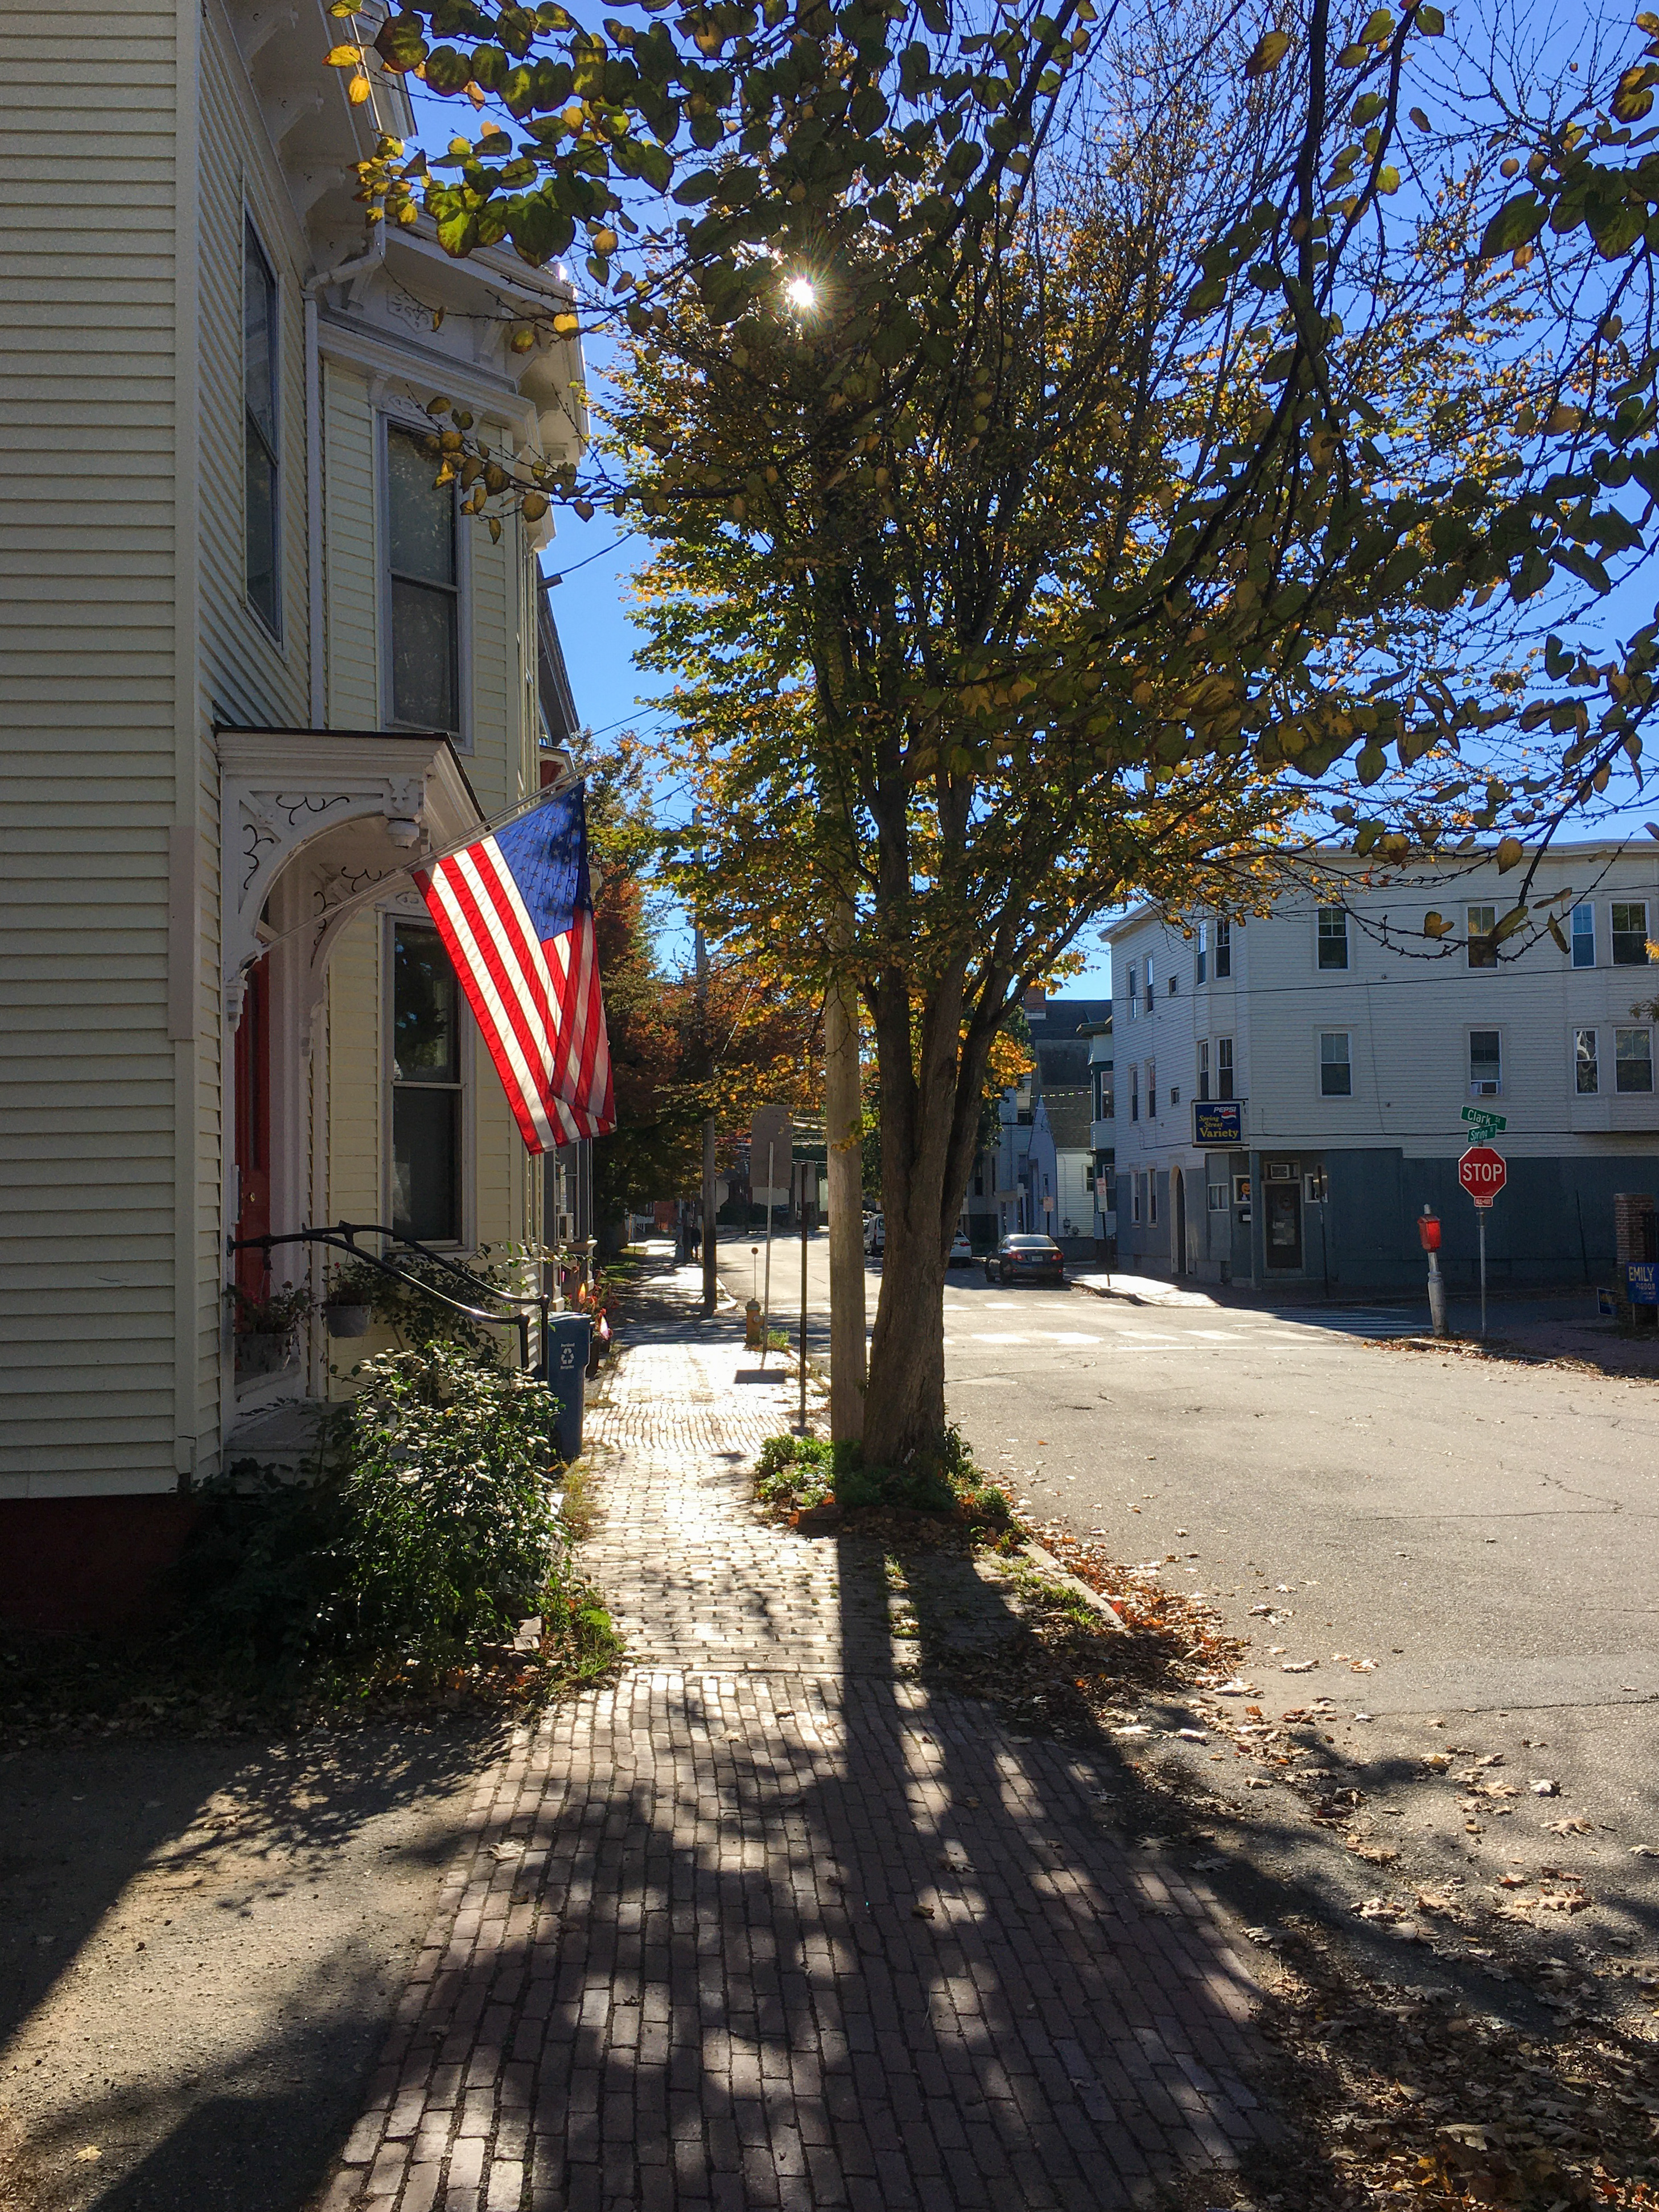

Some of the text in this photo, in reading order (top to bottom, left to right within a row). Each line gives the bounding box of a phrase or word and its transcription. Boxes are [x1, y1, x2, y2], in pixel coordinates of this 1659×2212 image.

[1467, 1109, 1491, 1126] Clark
[1199, 1127, 1238, 1139] Variety
[1470, 1128, 1488, 1141] Spring
[1463, 1163, 1502, 1182] STOP
[1628, 1266, 1654, 1282] EMILY
